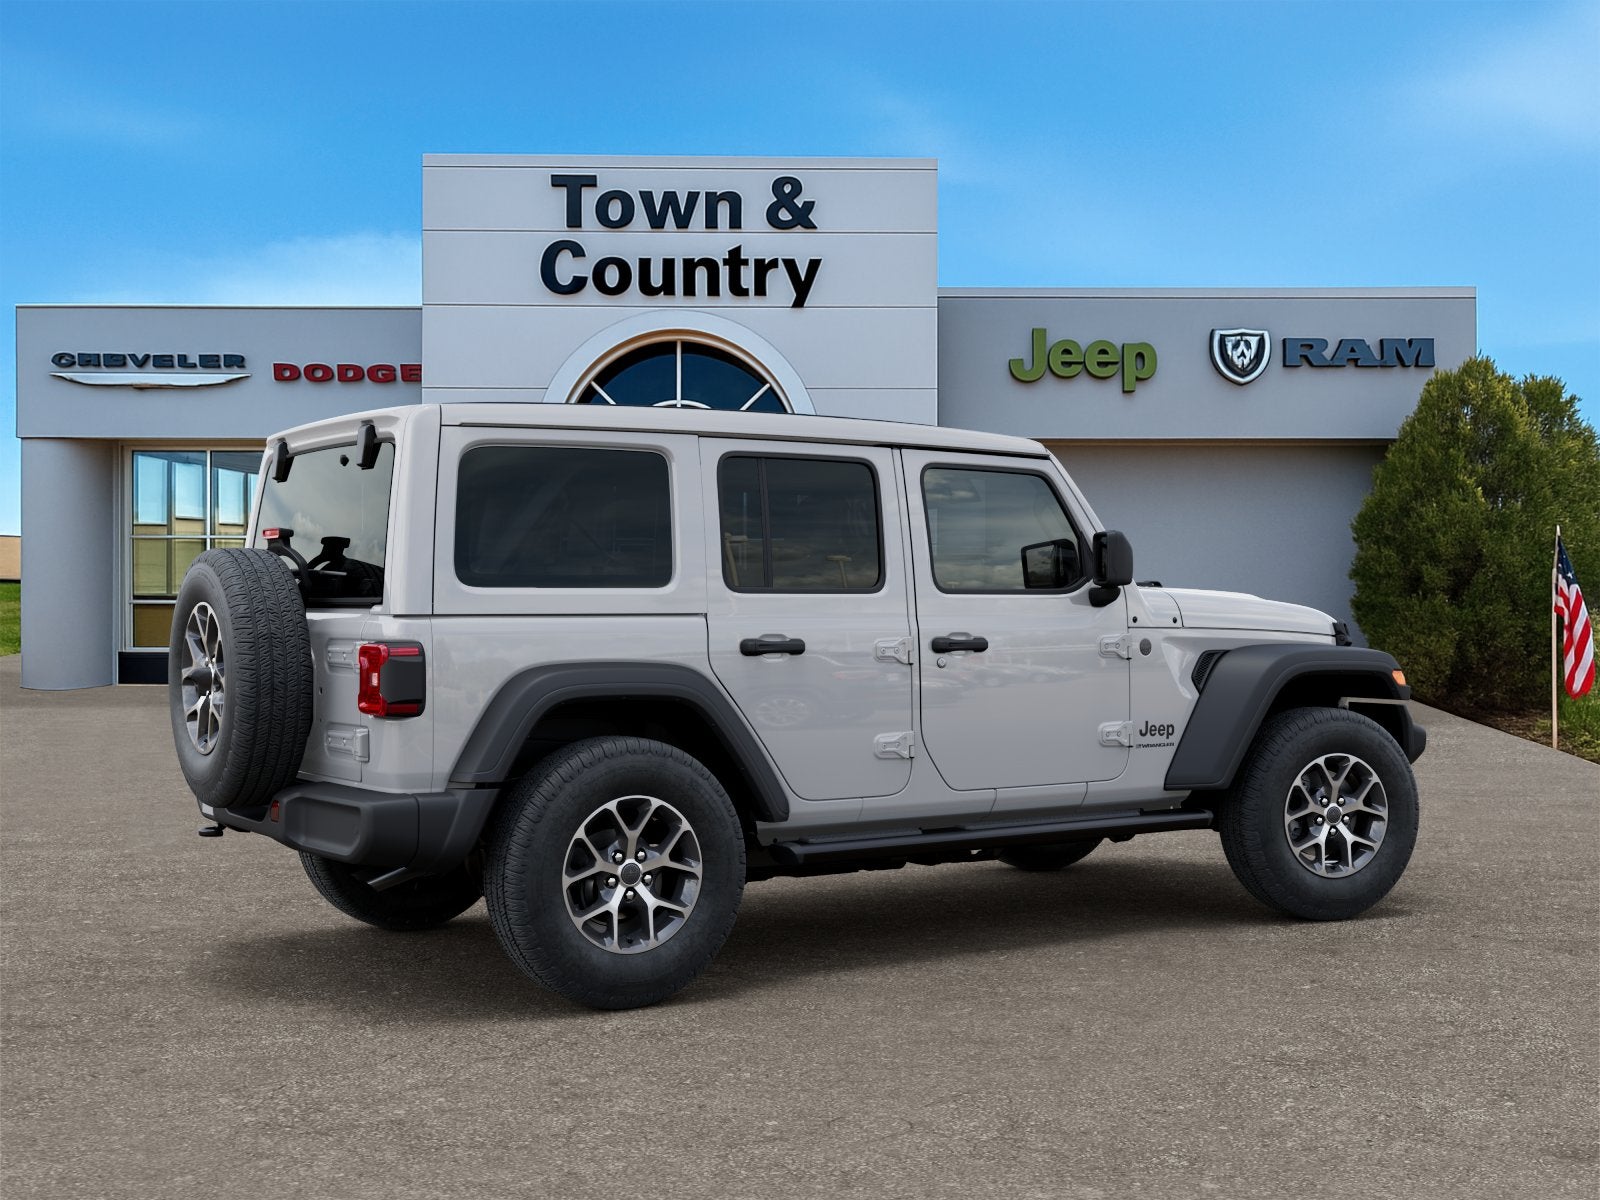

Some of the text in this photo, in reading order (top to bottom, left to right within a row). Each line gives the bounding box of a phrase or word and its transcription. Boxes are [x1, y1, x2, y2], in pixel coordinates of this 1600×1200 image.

[550, 174, 818, 230] Town &
[540, 239, 823, 309] Country
[273, 362, 422, 384] DODGE
[1008, 327, 1158, 393] Jeep
[1282, 337, 1436, 368] RAM
[1139, 720, 1175, 740] Jeep
